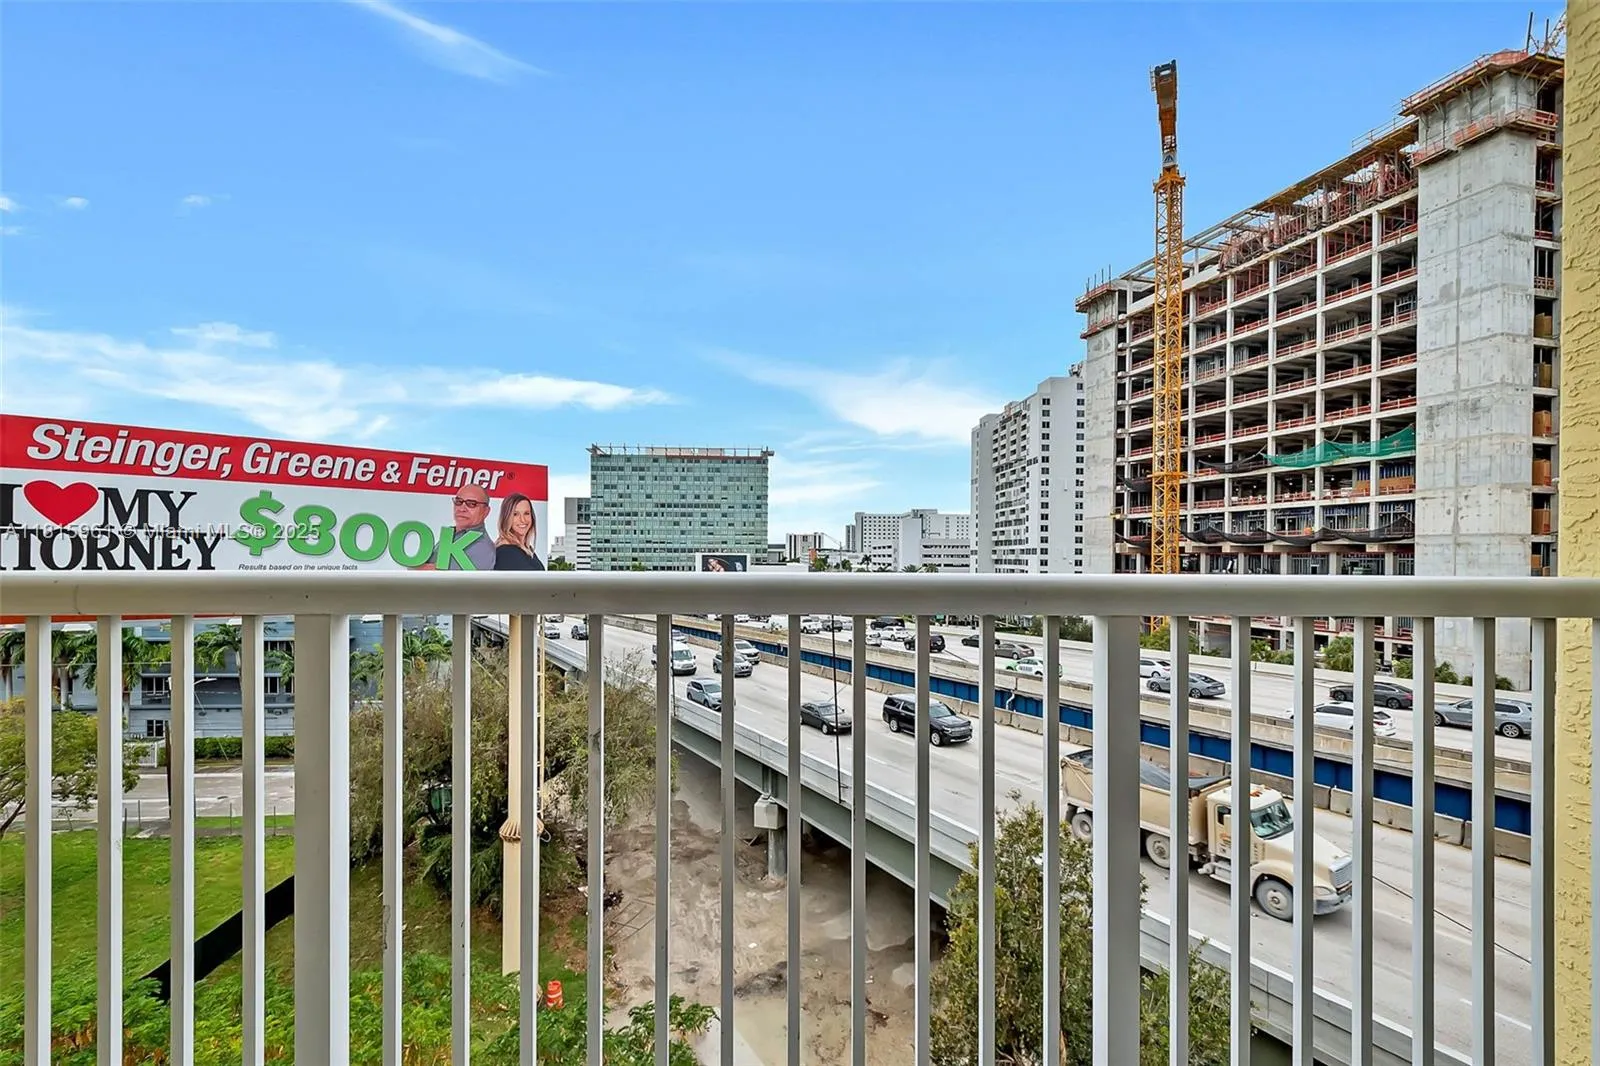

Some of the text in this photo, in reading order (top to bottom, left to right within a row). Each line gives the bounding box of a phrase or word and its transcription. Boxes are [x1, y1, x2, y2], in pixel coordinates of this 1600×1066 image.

[27, 424, 231, 478] Steinger,
[242, 442, 376, 482] Greene
[381, 461, 401, 484] &
[98, 487, 197, 529] MY
[233, 489, 484, 571] $800K
[238, 563, 267, 571] Results
[269, 563, 292, 571] based
[341, 563, 358, 571] facts
